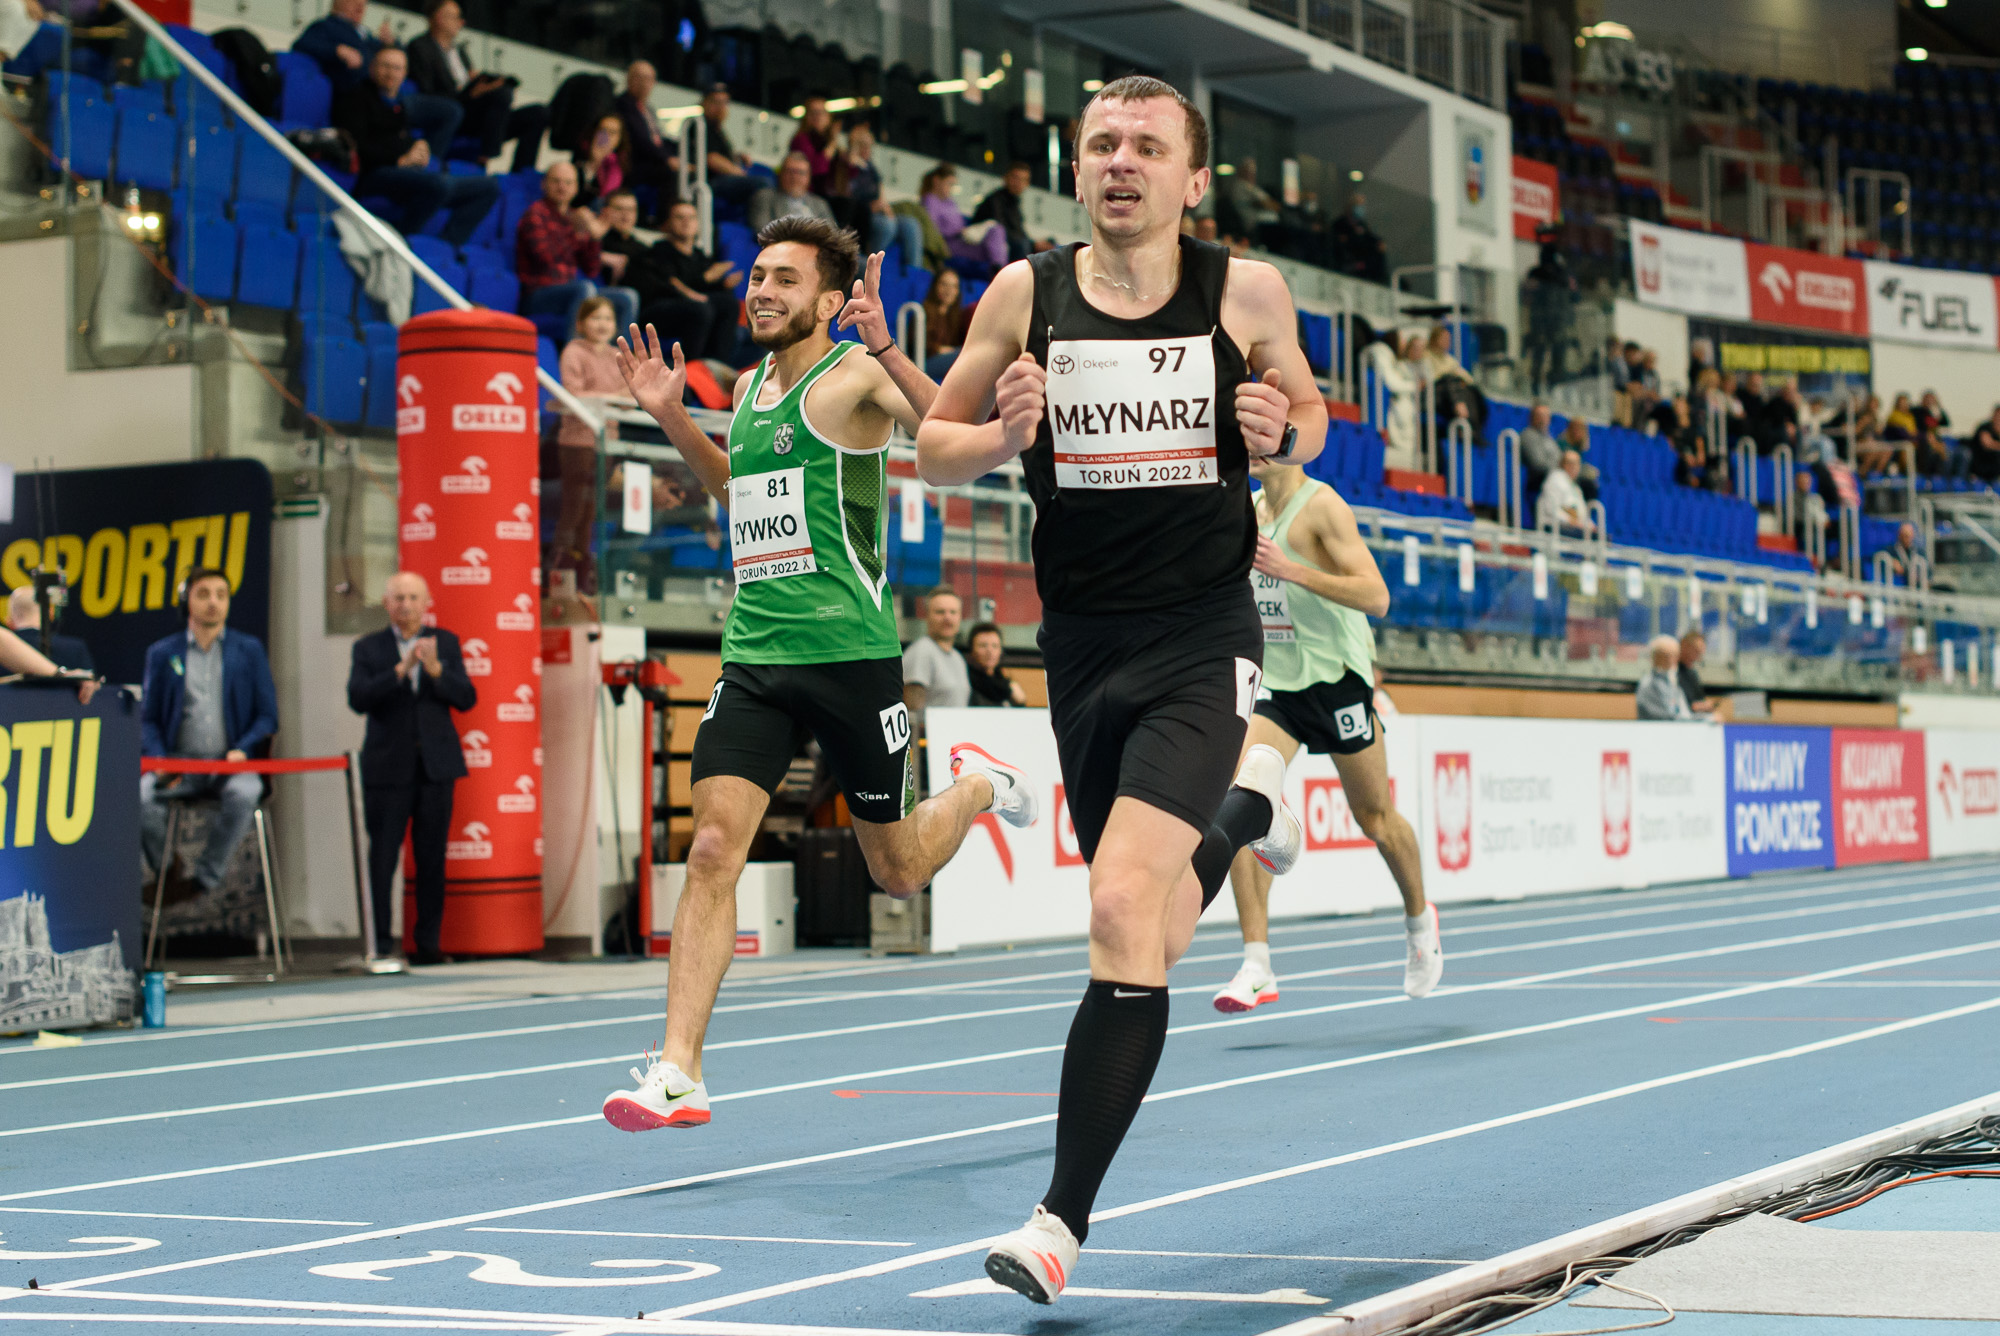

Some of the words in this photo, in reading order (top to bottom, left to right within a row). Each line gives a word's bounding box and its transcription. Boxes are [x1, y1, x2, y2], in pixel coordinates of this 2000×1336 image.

[1901, 291, 1981, 333] FUEL
[1083, 359, 1119, 370] Okęcie
[1148, 346, 1186, 373] 97
[1054, 397, 1210, 435] MŁYNARZ
[1080, 464, 1141, 484] TORUŃ
[1148, 465, 1192, 482] 2022
[1126, 451, 1179, 461] MISTRZOSTWA
[1180, 450, 1204, 458] POLSKI
[767, 476, 790, 498] 81
[0, 511, 250, 624] SPORTU
[771, 561, 799, 575] 2022
[885, 709, 909, 743] 10
[1734, 742, 1808, 791] KUJAWY
[1841, 743, 1904, 789] KUJAWY
[1735, 801, 1823, 854] POMORZE
[1842, 797, 1919, 847] POMORZE
